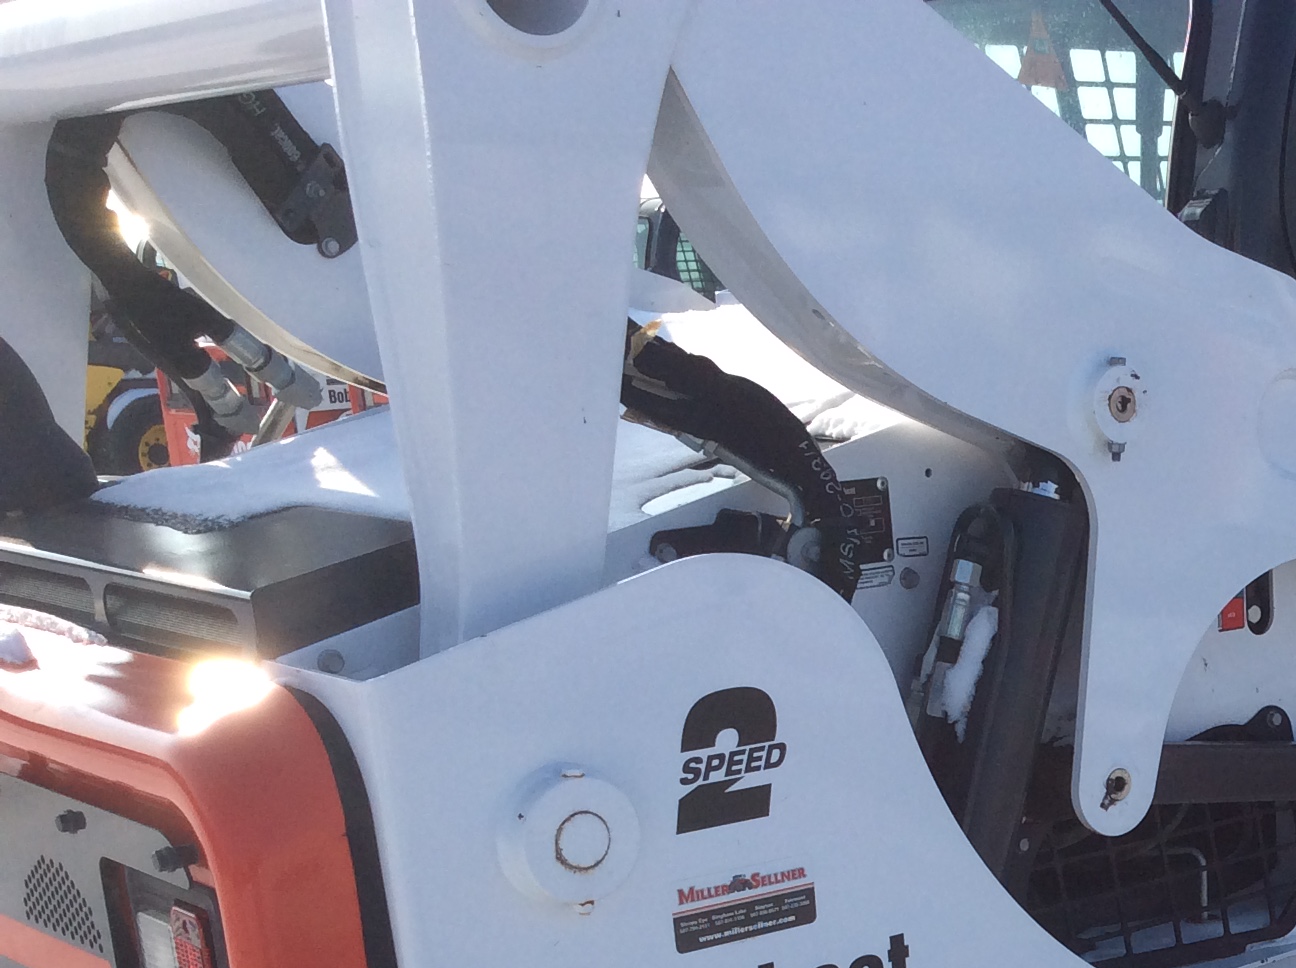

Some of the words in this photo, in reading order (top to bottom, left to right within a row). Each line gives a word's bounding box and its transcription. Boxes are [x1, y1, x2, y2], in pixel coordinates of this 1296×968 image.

[676, 686, 778, 835] 2
[679, 742, 788, 786] SPEED
[749, 866, 808, 890] SELLNER
